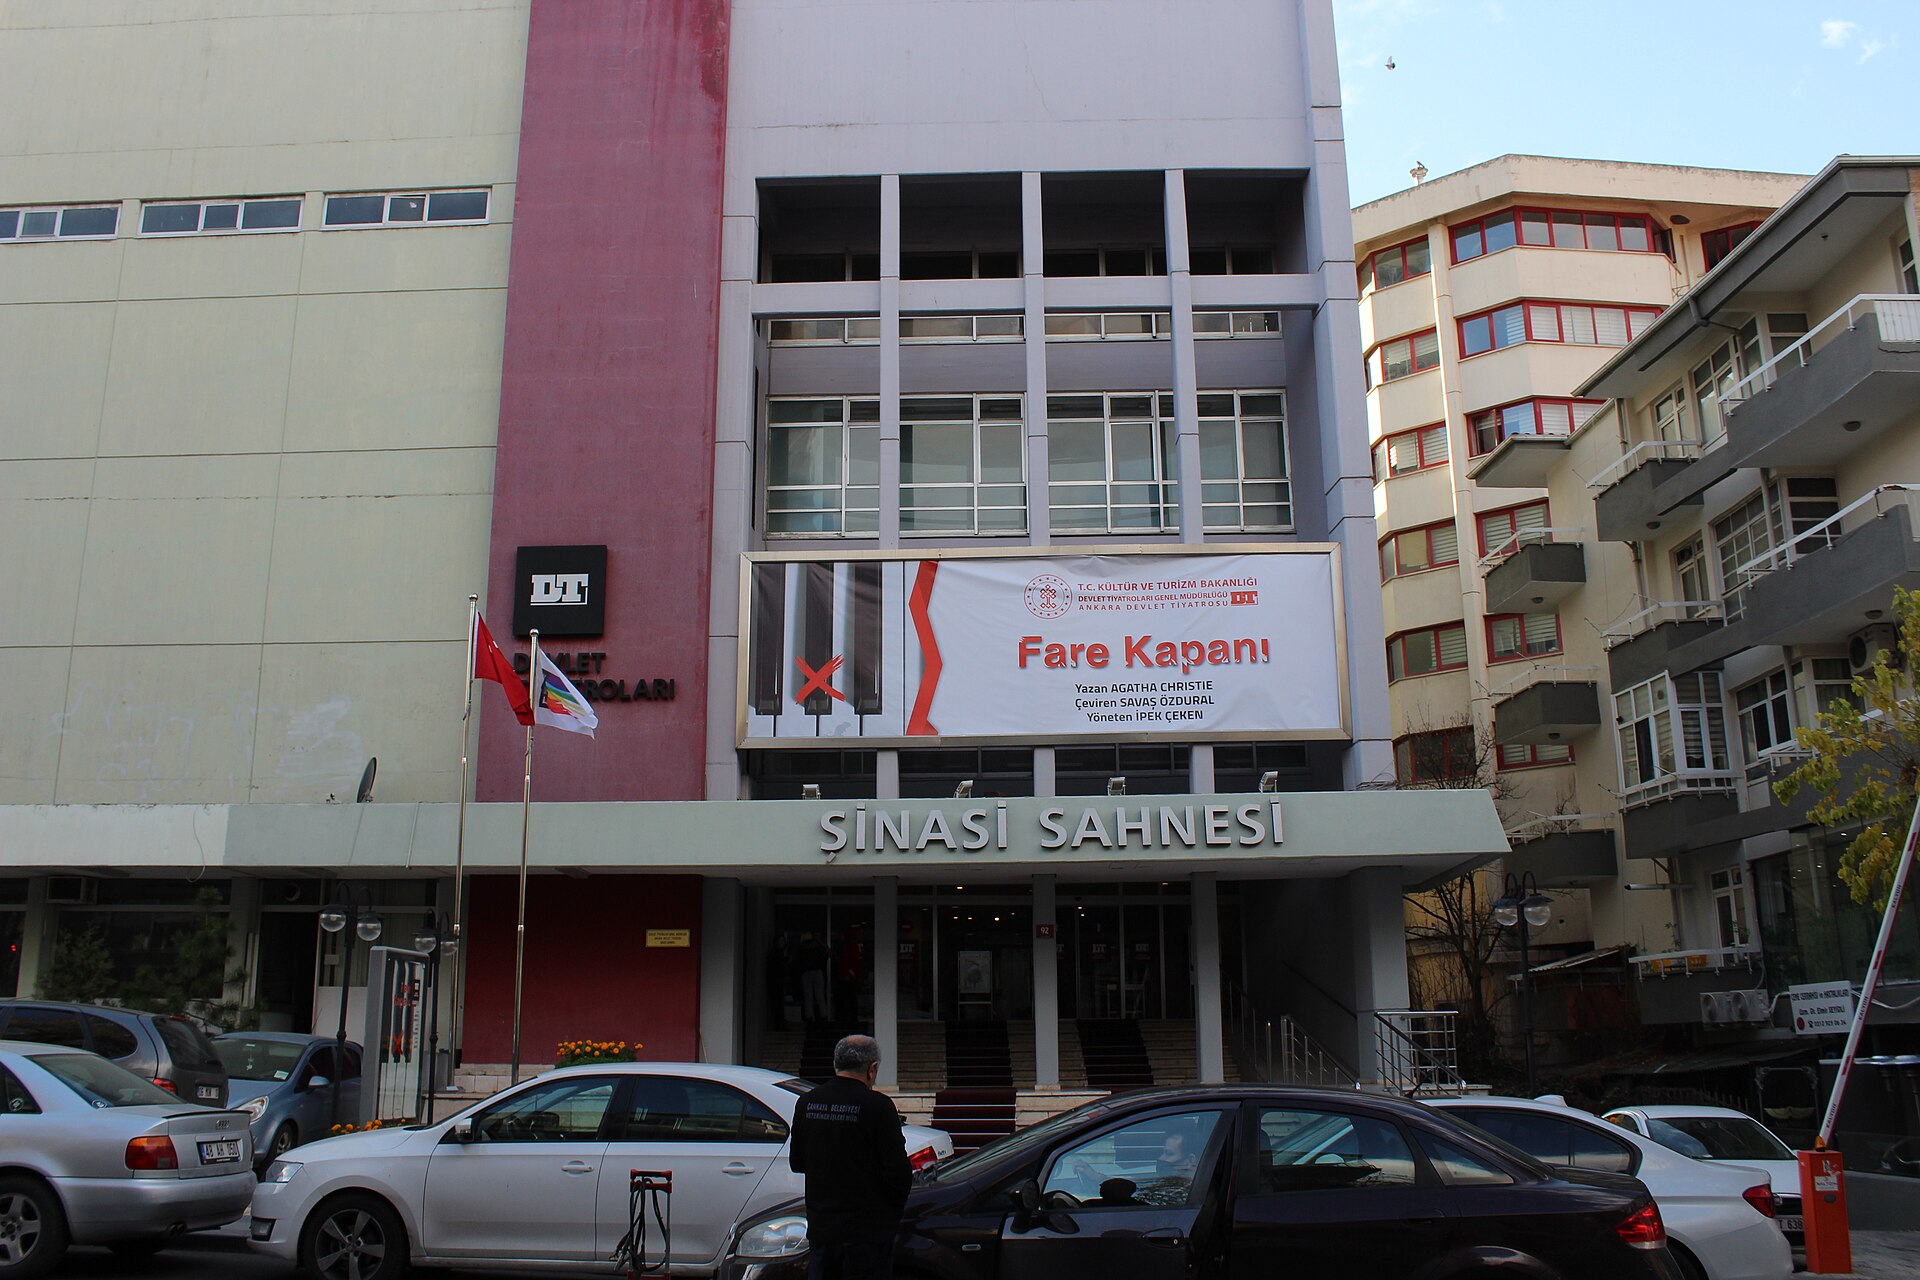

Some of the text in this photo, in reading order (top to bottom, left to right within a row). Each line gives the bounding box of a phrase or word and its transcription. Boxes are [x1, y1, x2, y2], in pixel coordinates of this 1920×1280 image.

[530, 573, 590, 606] DT
[1077, 577, 1258, 592] T.C. KÜLTÜR VE TURİZM BAKANLIĞI
[1078, 591, 1228, 603] DEVLET TİYATROLARI GENEL MÜDÜRLÜĞÜ
[1231, 592, 1259, 606] DT
[1170, 600, 1228, 609] TİYATROSU
[1017, 635, 1270, 673] Fare Kapanı
[1074, 680, 1213, 694] Yazan AGATHA CHRISTIE
[1074, 694, 1214, 710] Çeviren SAVAŞ ÖZDURAL
[1086, 709, 1203, 723] Yöneten İPEK ÇEKEN
[820, 795, 1285, 863] ŞİNASİ SAHNESİ
[1040, 926, 1050, 935] 92
